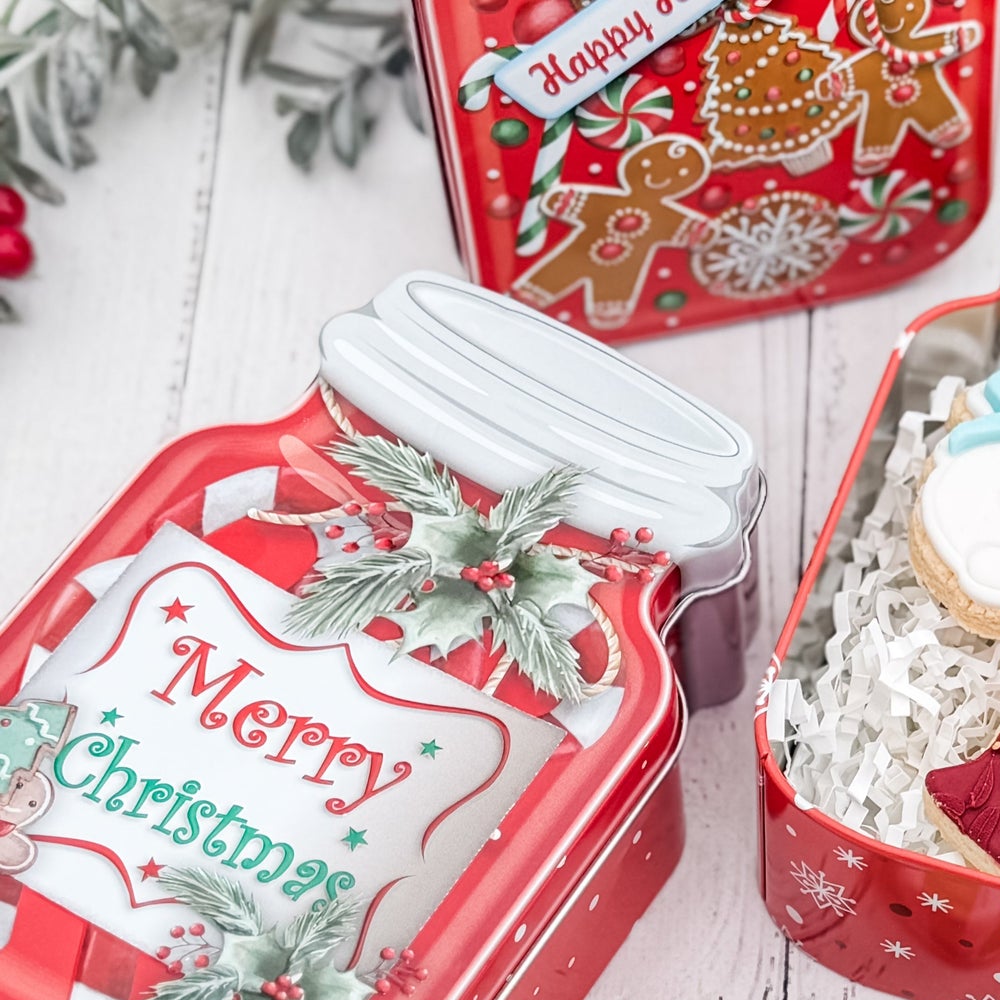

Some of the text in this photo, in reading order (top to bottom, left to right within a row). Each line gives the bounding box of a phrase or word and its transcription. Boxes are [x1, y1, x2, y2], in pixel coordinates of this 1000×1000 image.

[528, 10, 655, 96] Happy
[150, 635, 413, 816] Merry
[54, 731, 356, 912] Christmas
